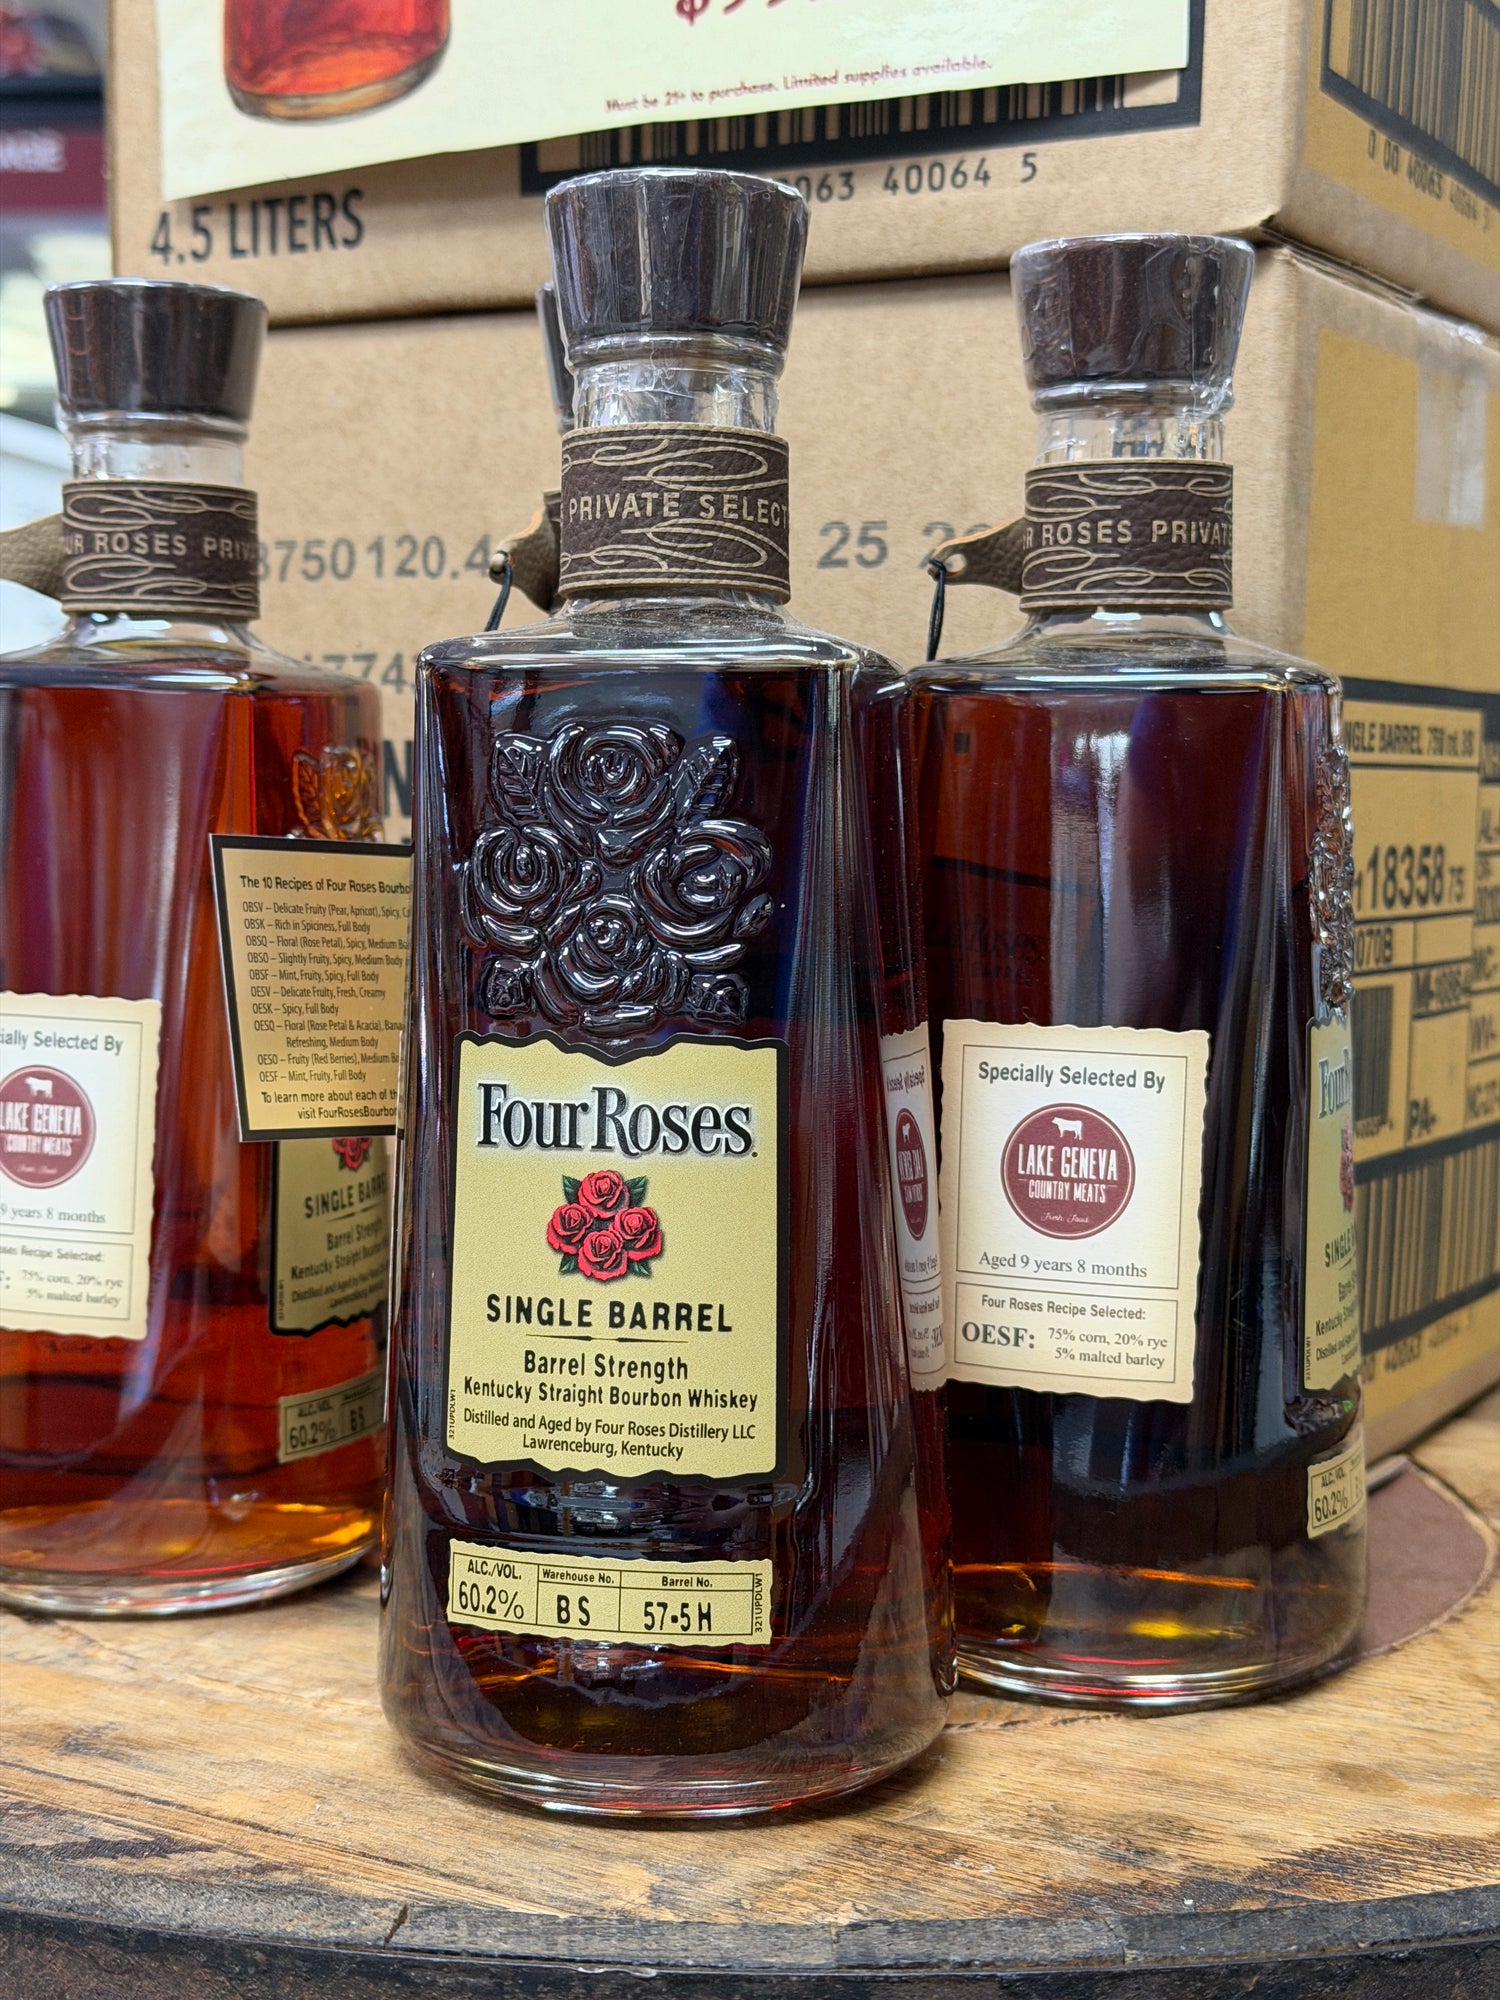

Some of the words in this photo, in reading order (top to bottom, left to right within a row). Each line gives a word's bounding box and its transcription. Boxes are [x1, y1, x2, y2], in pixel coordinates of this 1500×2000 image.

[783, 69, 838, 89] Limited
[844, 65, 907, 86] supplies
[911, 55, 992, 76] available.
[883, 157, 991, 195] 40064
[1020, 152, 1037, 183] 5
[150, 205, 213, 265] 4.5
[228, 189, 364, 258] LITERS
[569, 492, 681, 523] PRIVATE
[94, 532, 188, 557] ROSES
[817, 520, 888, 569] 25
[1042, 520, 1132, 547] ROSES
[240, 875, 260, 889] The
[262, 877, 273, 889] 10
[275, 877, 313, 892] Recipes
[315, 877, 325, 891] of
[326, 879, 347, 891] Four
[349, 880, 376, 893] Roses
[379, 881, 411, 894] Bourbo
[242, 901, 264, 913] OBSV
[273, 902, 304, 915] Delicate
[243, 918, 265, 930] OBSK
[274, 919, 289, 931] Rich
[291, 920, 299, 931] in
[338, 921, 351, 932] Full
[352, 921, 370, 934] Body
[245, 935, 268, 948] OBSQ
[277, 936, 298, 948] Floral
[300, 936, 320, 949] (Rose
[322, 937, 345, 950] Petal),
[346, 938, 368, 951] Spicy,
[368, 939, 398, 950] Medium
[278, 953, 306, 966] Slightly
[308, 954, 331, 967] Fruity,
[332, 954, 352, 967] Spicy,
[354, 955, 384, 965] Medium
[249, 969, 270, 980] OBSF
[279, 969, 300, 981] Mint,
[300, 970, 323, 983] Fruity,
[324, 970, 345, 983] Spicy,
[347, 971, 361, 981] Full
[361, 971, 379, 984] Body
[251, 986, 271, 997] OESV
[281, 986, 311, 998] Delicate
[312, 987, 336, 999] Fruity,
[336, 987, 359, 999] Fresh,
[360, 988, 385, 1000] Creamy
[252, 1003, 273, 1014] OESK
[282, 1003, 305, 1017] Spicy,
[305, 1003, 320, 1015] Full
[320, 1003, 339, 1016] Body
[254, 1020, 275, 1032] OESQ
[284, 1020, 306, 1031] Floral
[307, 1020, 328, 1032] (Rose
[329, 1020, 348, 1031] Petal
[33, 1030, 99, 1051] Selected
[104, 1035, 123, 1056] By
[286, 1037, 328, 1050] Refreshing,
[329, 1037, 361, 1048] Medium
[361, 1037, 379, 1049] Body
[287, 1054, 310, 1066] Fruity
[311, 1054, 329, 1066] (Red
[330, 1054, 360, 1066] Berries),
[361, 1054, 390, 1064] Medium
[260, 1071, 279, 1082] OESF
[288, 1070, 308, 1081] Mint,
[309, 1070, 333, 1083] Fruity,
[333, 1070, 347, 1081] Full
[348, 1070, 366, 1081] Body
[978, 1061, 1054, 1088] Specially
[1059, 1065, 1137, 1088] Selected
[1143, 1070, 1165, 1094] By
[261, 1091, 272, 1103] To
[274, 1091, 298, 1103] learn
[301, 1092, 325, 1102] more
[327, 1090, 353, 1101] about
[355, 1089, 377, 1100] each
[379, 1089, 388, 1100] of
[298, 1108, 316, 1119] visit
[1017, 1143, 1055, 1177] LAKE
[1061, 1146, 1118, 1180] GENEVA
[304, 1185, 354, 1219] SINGLE
[1028, 1180, 1071, 1201] COUNTRY
[1074, 1184, 1107, 1204] MEATS
[11, 1207, 42, 1221] years
[46, 1206, 54, 1220] 8
[58, 1211, 107, 1223] months
[291, 1259, 332, 1280] Kentucky
[978, 1251, 1017, 1270] Aged
[1020, 1254, 1029, 1268] 9
[1033, 1257, 1073, 1273] years
[1077, 1259, 1086, 1274] 8
[1091, 1260, 1147, 1278] months
[486, 1293, 592, 1327] SINGLE
[608, 1300, 733, 1332] BARREL
[981, 1294, 1005, 1309] Four
[1009, 1297, 1043, 1312] Roses
[1046, 1300, 1086, 1318] Recipe
[1090, 1304, 1146, 1320] Selected:
[961, 1320, 1035, 1349] OESF:
[1048, 1327, 1076, 1341] 75%
[1079, 1332, 1110, 1345] corn,
[1114, 1332, 1144, 1347] 20%
[1147, 1337, 1168, 1350] rye
[523, 1349, 585, 1376] Barrel
[594, 1353, 688, 1384] Strength
[1054, 1346, 1075, 1360] 5%
[1079, 1350, 1121, 1365] malted
[1125, 1352, 1165, 1369] barley
[464, 1376, 532, 1403] Kentucky
[538, 1382, 603, 1407] Straight
[609, 1386, 681, 1407] Bourbon
[688, 1389, 758, 1412] Whiskey
[448, 1389, 456, 1440] 321UPDLW1
[464, 1408, 509, 1427] Distilled
[513, 1414, 535, 1430] and
[538, 1415, 572, 1437] Aged
[576, 1418, 592, 1436] by
[595, 1419, 624, 1437] Four
[628, 1422, 666, 1438] Roses
[669, 1423, 729, 1443] Distillery
[732, 1425, 756, 1439] LLC
[523, 1434, 618, 1458] Lawrenceburg,
[621, 1441, 684, 1461] Kentucky
[1314, 1487, 1348, 1522] 60.2%
[467, 1558, 522, 1580] ALC./VOL.
[542, 1568, 596, 1584] Warehouse
[598, 1573, 615, 1585] No.
[661, 1576, 694, 1588] Barrel
[696, 1577, 713, 1588] No.
[459, 1580, 524, 1620] 60.2%
[754, 1573, 763, 1634] 321UPDLW1
